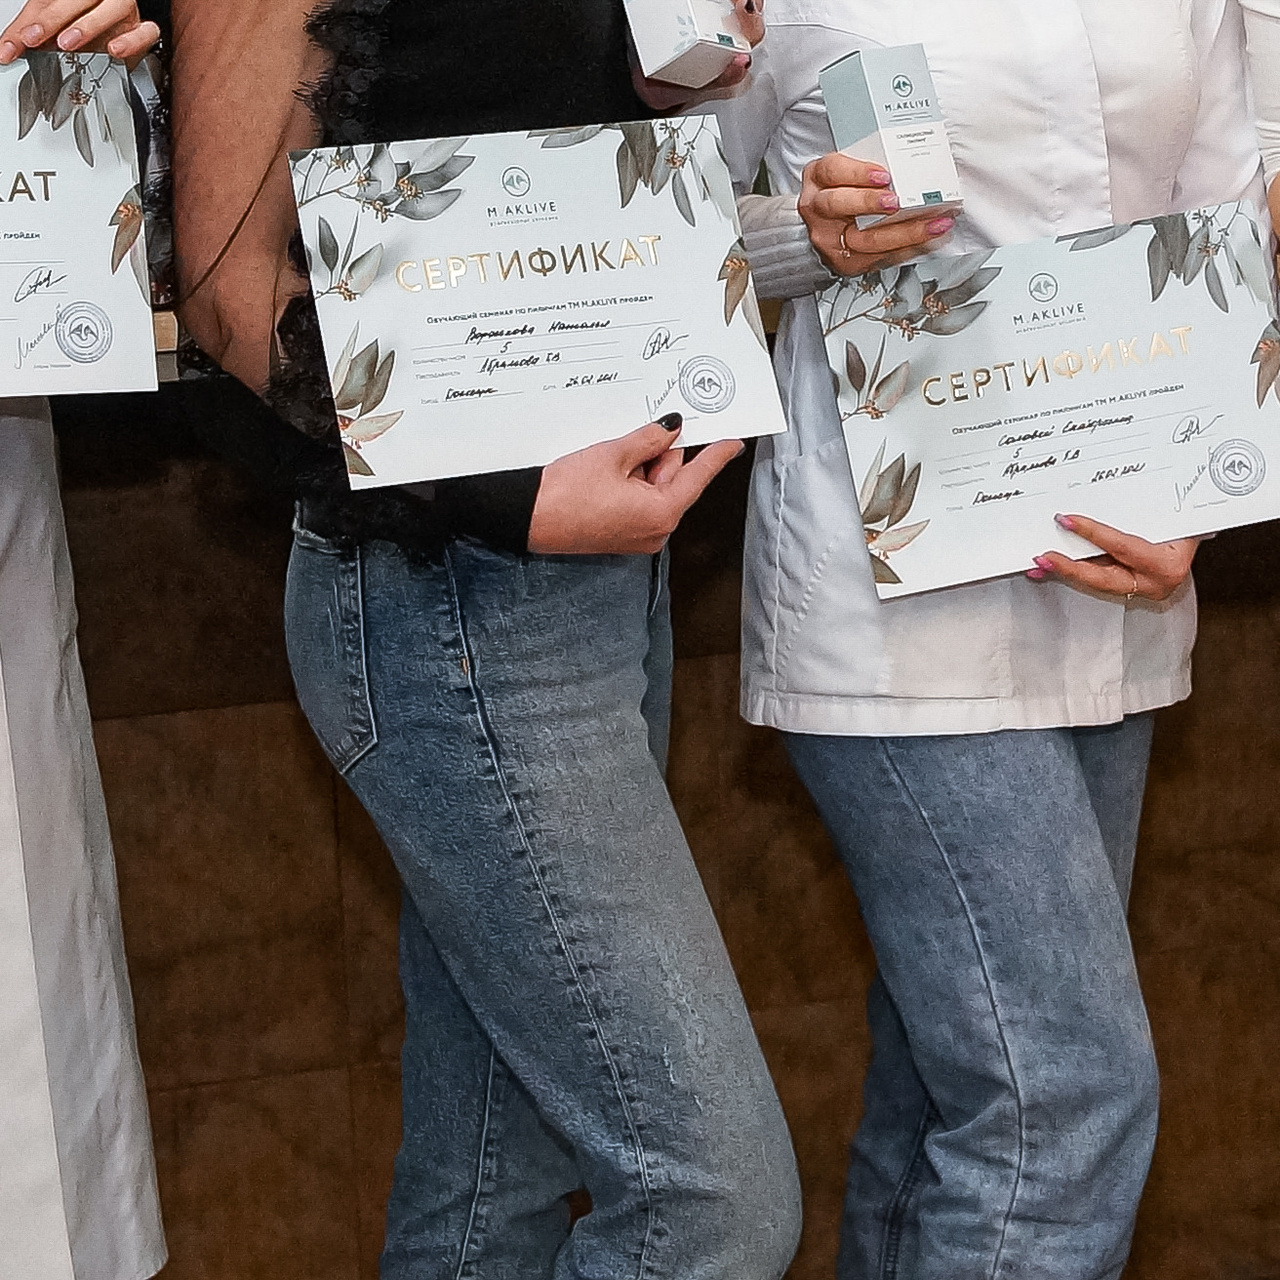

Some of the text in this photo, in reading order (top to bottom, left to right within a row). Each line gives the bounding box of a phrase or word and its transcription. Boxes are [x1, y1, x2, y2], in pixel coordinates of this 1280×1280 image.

[0, 171, 57, 203] АТ
[394, 234, 662, 293] СЕРТИФИКАТ
[1013, 302, 1085, 326] M.AKLIVE
[922, 325, 1193, 407] СЕРТИФИКАТ
